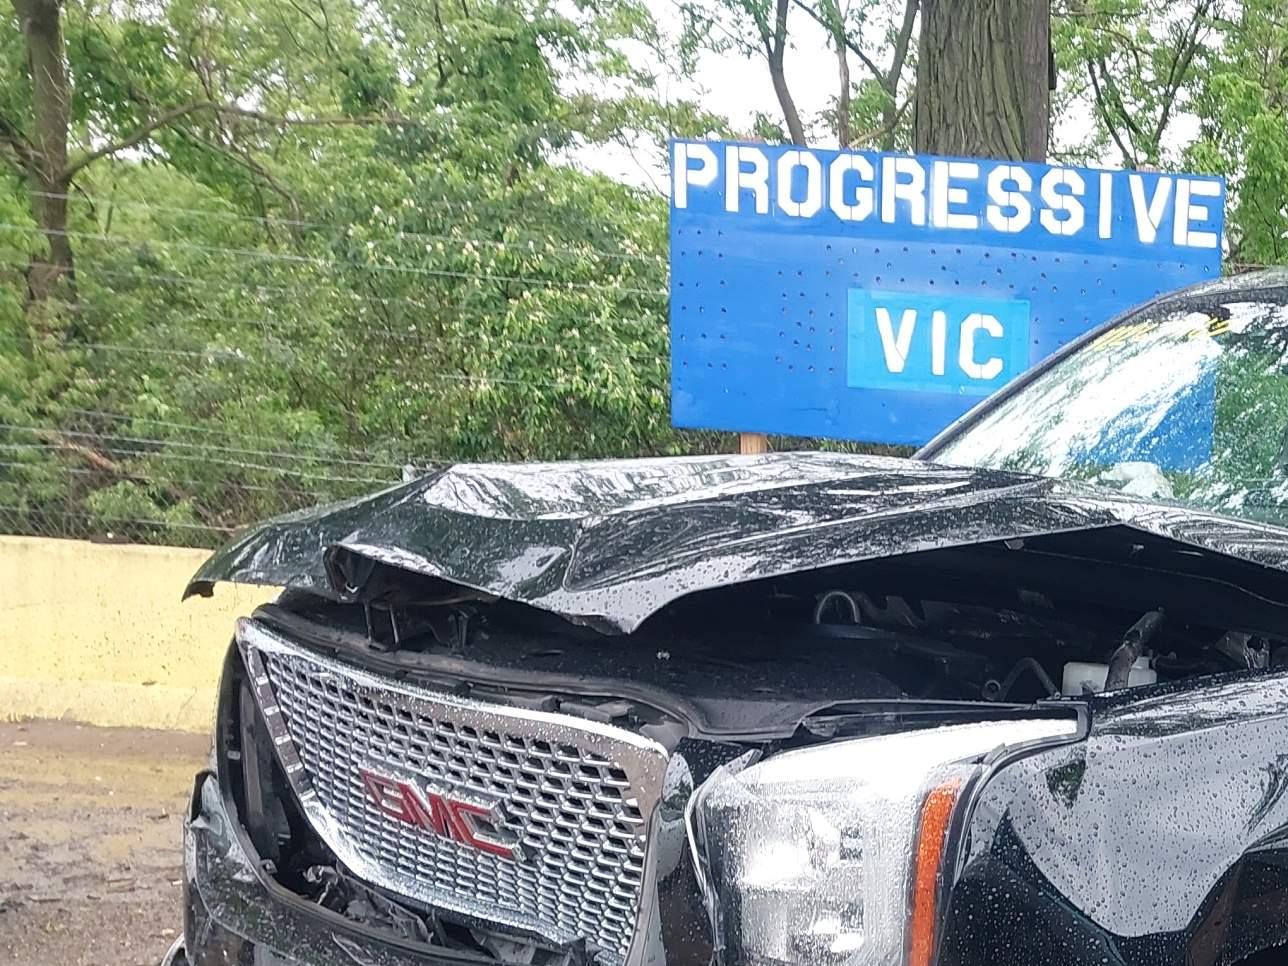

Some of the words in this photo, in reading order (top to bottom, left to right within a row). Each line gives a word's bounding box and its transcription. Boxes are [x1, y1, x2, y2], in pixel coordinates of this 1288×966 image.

[674, 142, 1222, 248] PROGRESSIVE
[875, 307, 1004, 380] VIC
[359, 761, 527, 863] GMC
